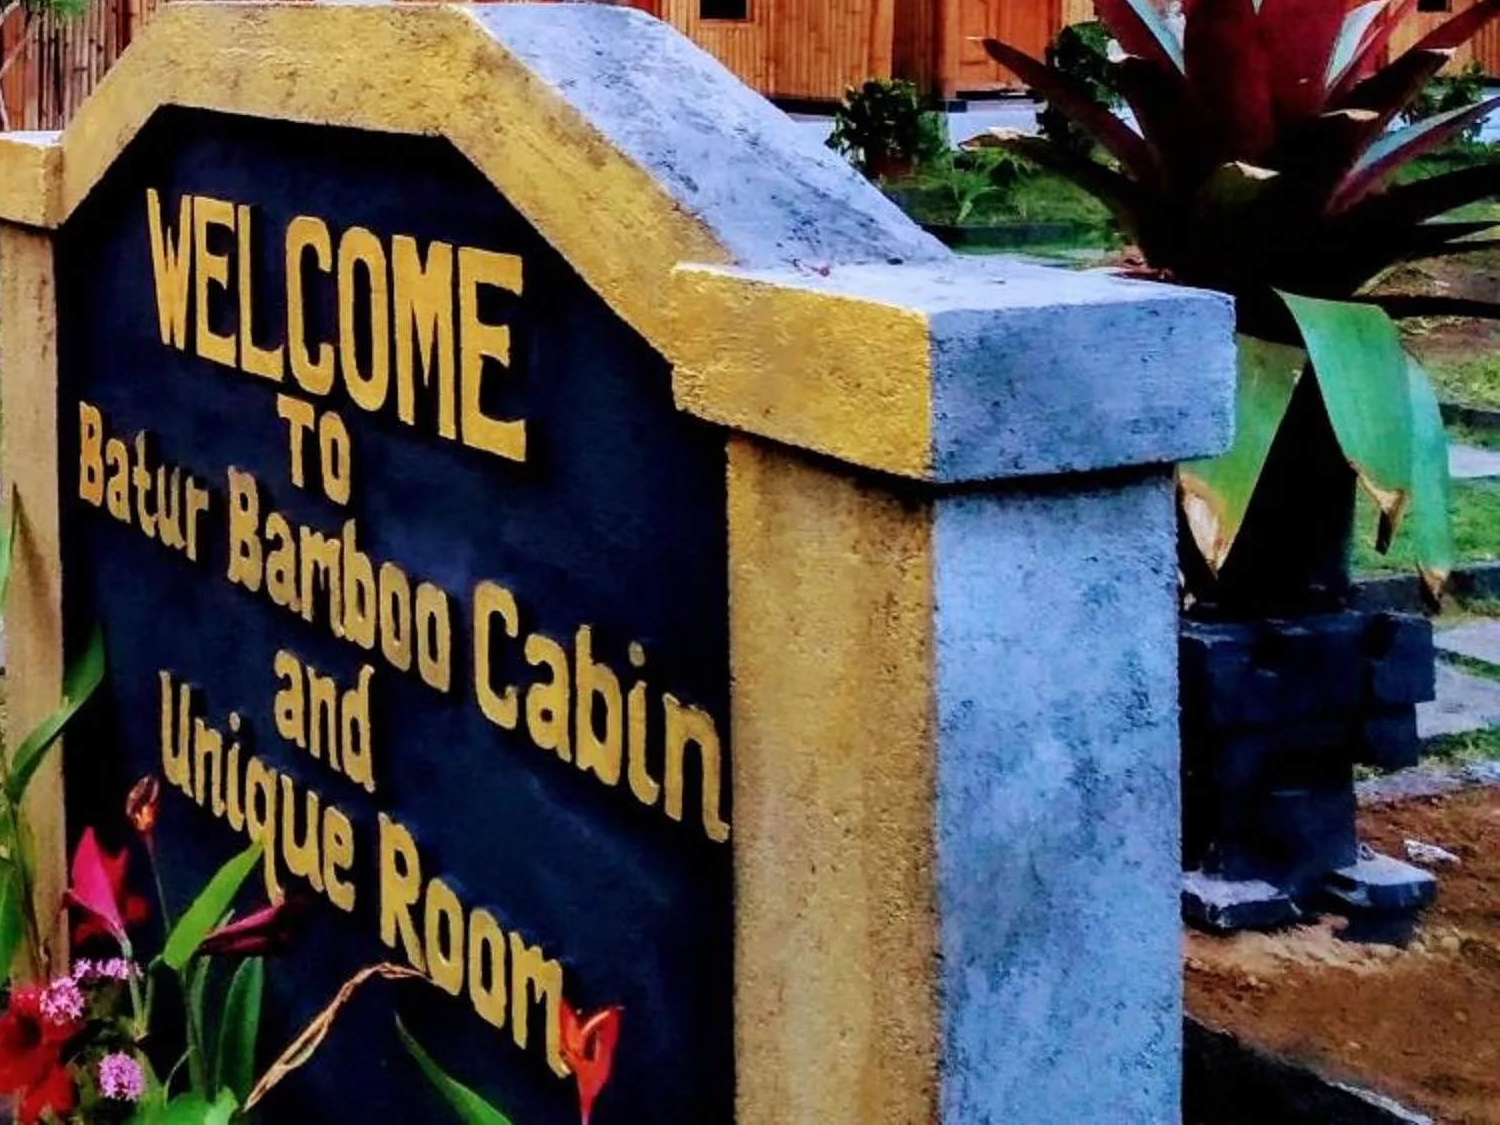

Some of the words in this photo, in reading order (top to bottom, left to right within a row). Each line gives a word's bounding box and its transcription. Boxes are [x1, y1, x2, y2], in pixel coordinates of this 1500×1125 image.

[146, 187, 527, 463] WELCOME
[276, 393, 352, 506] TO
[79, 400, 209, 562] Batur
[227, 465, 451, 693] Bamboo
[473, 580, 731, 843] Cabin
[274, 650, 375, 793] and
[159, 671, 355, 912] Unique
[378, 811, 572, 1078] Room
